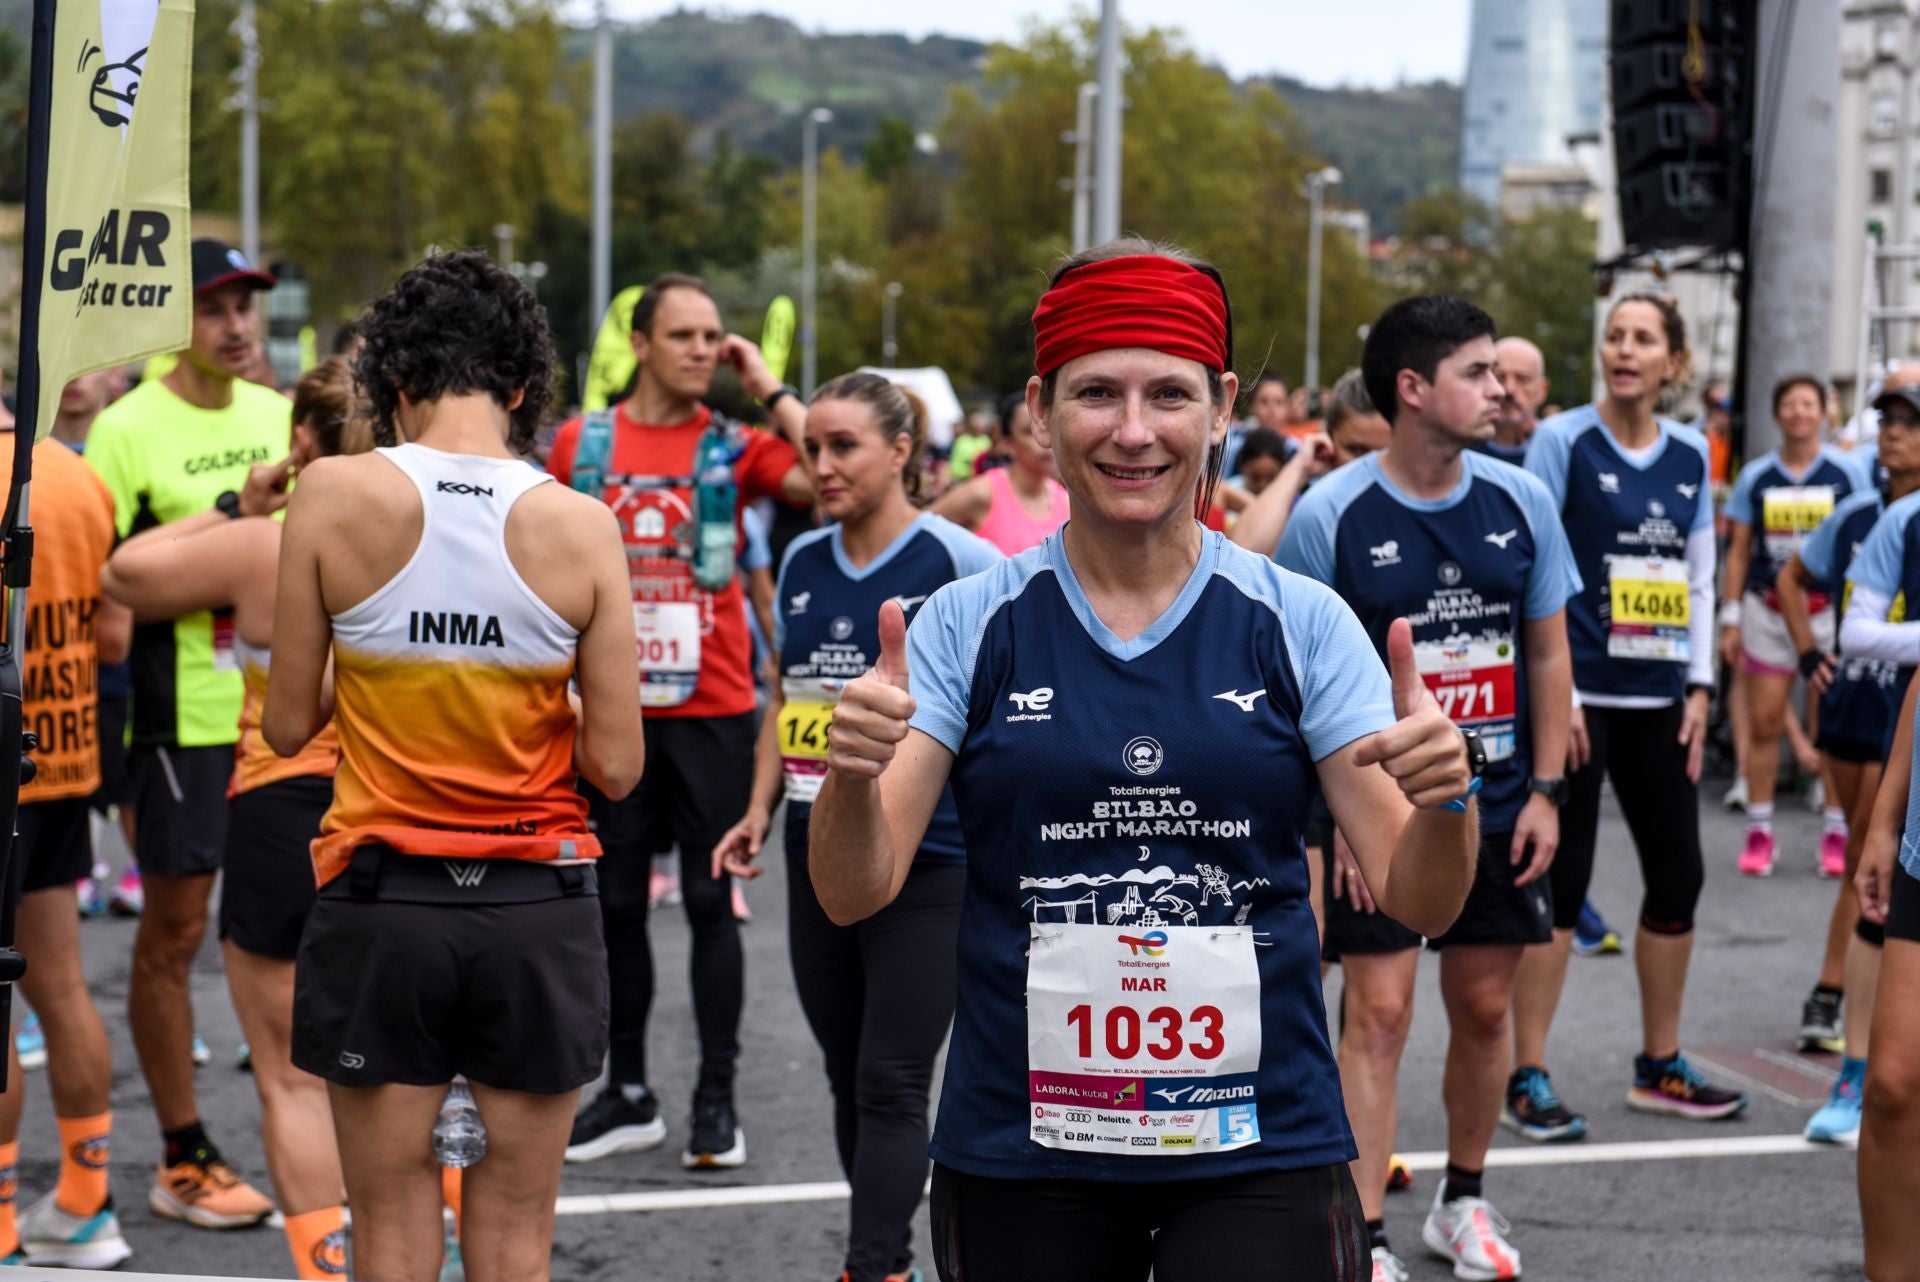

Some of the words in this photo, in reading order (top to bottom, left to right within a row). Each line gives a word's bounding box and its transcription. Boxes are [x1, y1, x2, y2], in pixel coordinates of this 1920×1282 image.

[101, 282, 117, 306] a
[121, 283, 173, 307] car
[1620, 591, 1686, 618] 14065
[409, 611, 504, 647] INMA
[1435, 680, 1495, 718] 771
[1109, 785, 1181, 796] TotalEnergies
[1092, 800, 1197, 818] BILBAO
[1041, 822, 1111, 841] NIGHT
[1116, 819, 1251, 838] MARATHON
[1118, 960, 1171, 970] TotalEnergies
[1121, 977, 1168, 992] MAR
[1067, 1004, 1226, 1061] 1033
[1035, 1083, 1080, 1097] LABORAL
[1082, 1089, 1108, 1100] kutxa
[1077, 1132, 1094, 1142] BM
[1227, 1113, 1253, 1142] 5
